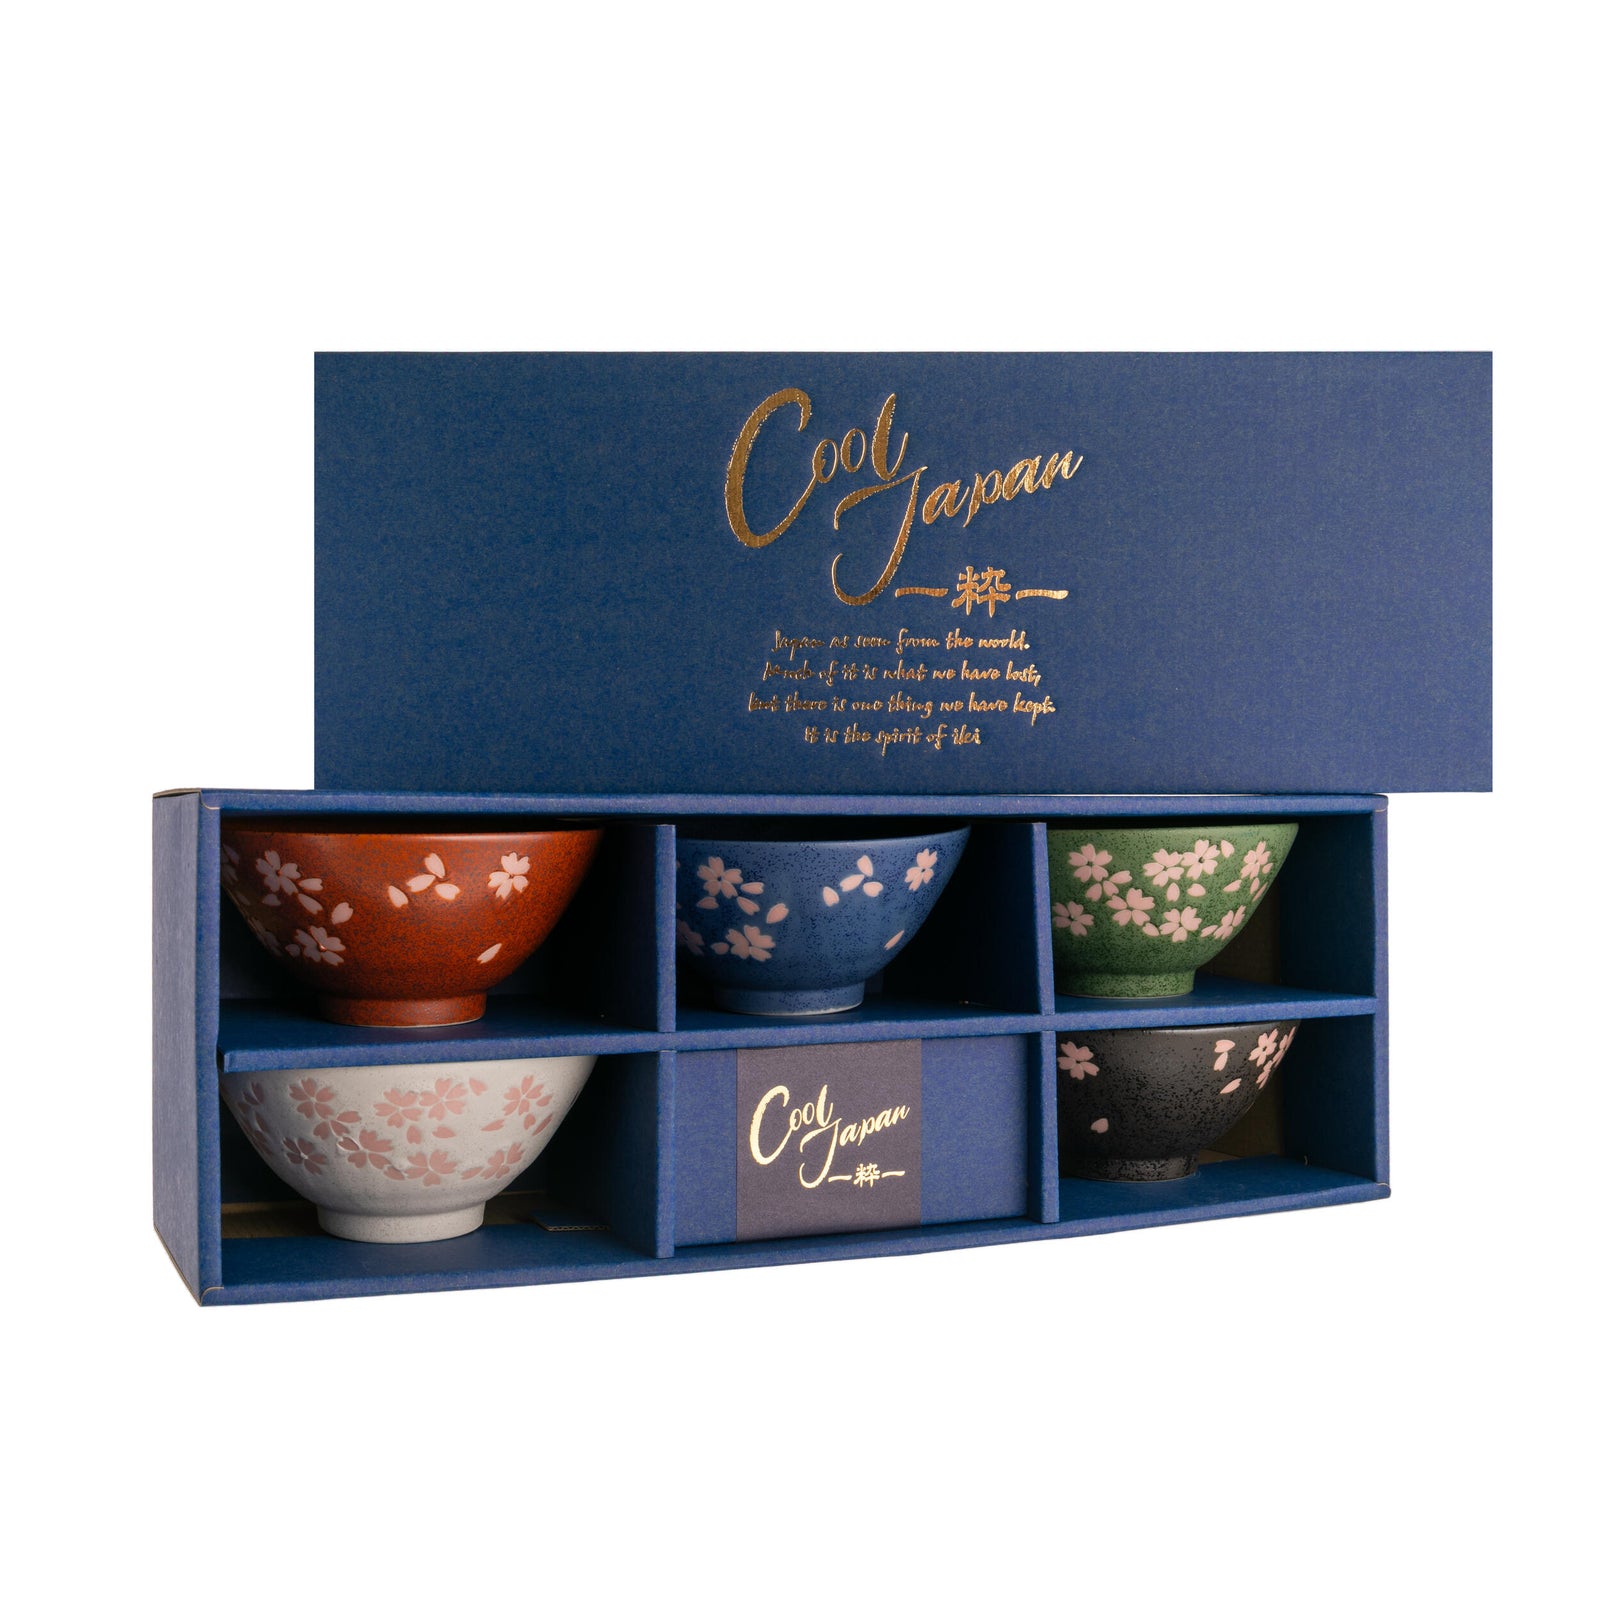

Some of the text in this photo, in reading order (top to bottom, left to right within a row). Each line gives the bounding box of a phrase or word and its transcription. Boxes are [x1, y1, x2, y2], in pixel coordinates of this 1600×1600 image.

[725, 388, 908, 547] Cool
[832, 451, 1083, 606] Japan
[896, 628, 940, 654] from
[946, 628, 973, 650] the
[978, 629, 1030, 650] world.
[819, 660, 839, 687] of
[842, 662, 858, 680] it
[862, 664, 878, 680] is
[883, 659, 928, 681] what
[932, 668, 956, 680] we
[961, 660, 1000, 681] have
[1005, 660, 1041, 687] lost,
[784, 690, 827, 712] there
[831, 695, 847, 712] is
[851, 699, 883, 711] one
[888, 690, 933, 719] thing
[939, 700, 964, 712] we
[968, 692, 1008, 712] have
[804, 725, 820, 744] It
[823, 727, 839, 743] is
[843, 722, 871, 744] the
[875, 726, 923, 757] spirit
[926, 723, 948, 750] of
[749, 1084, 834, 1166] Cool
[799, 1104, 910, 1189] Japan
